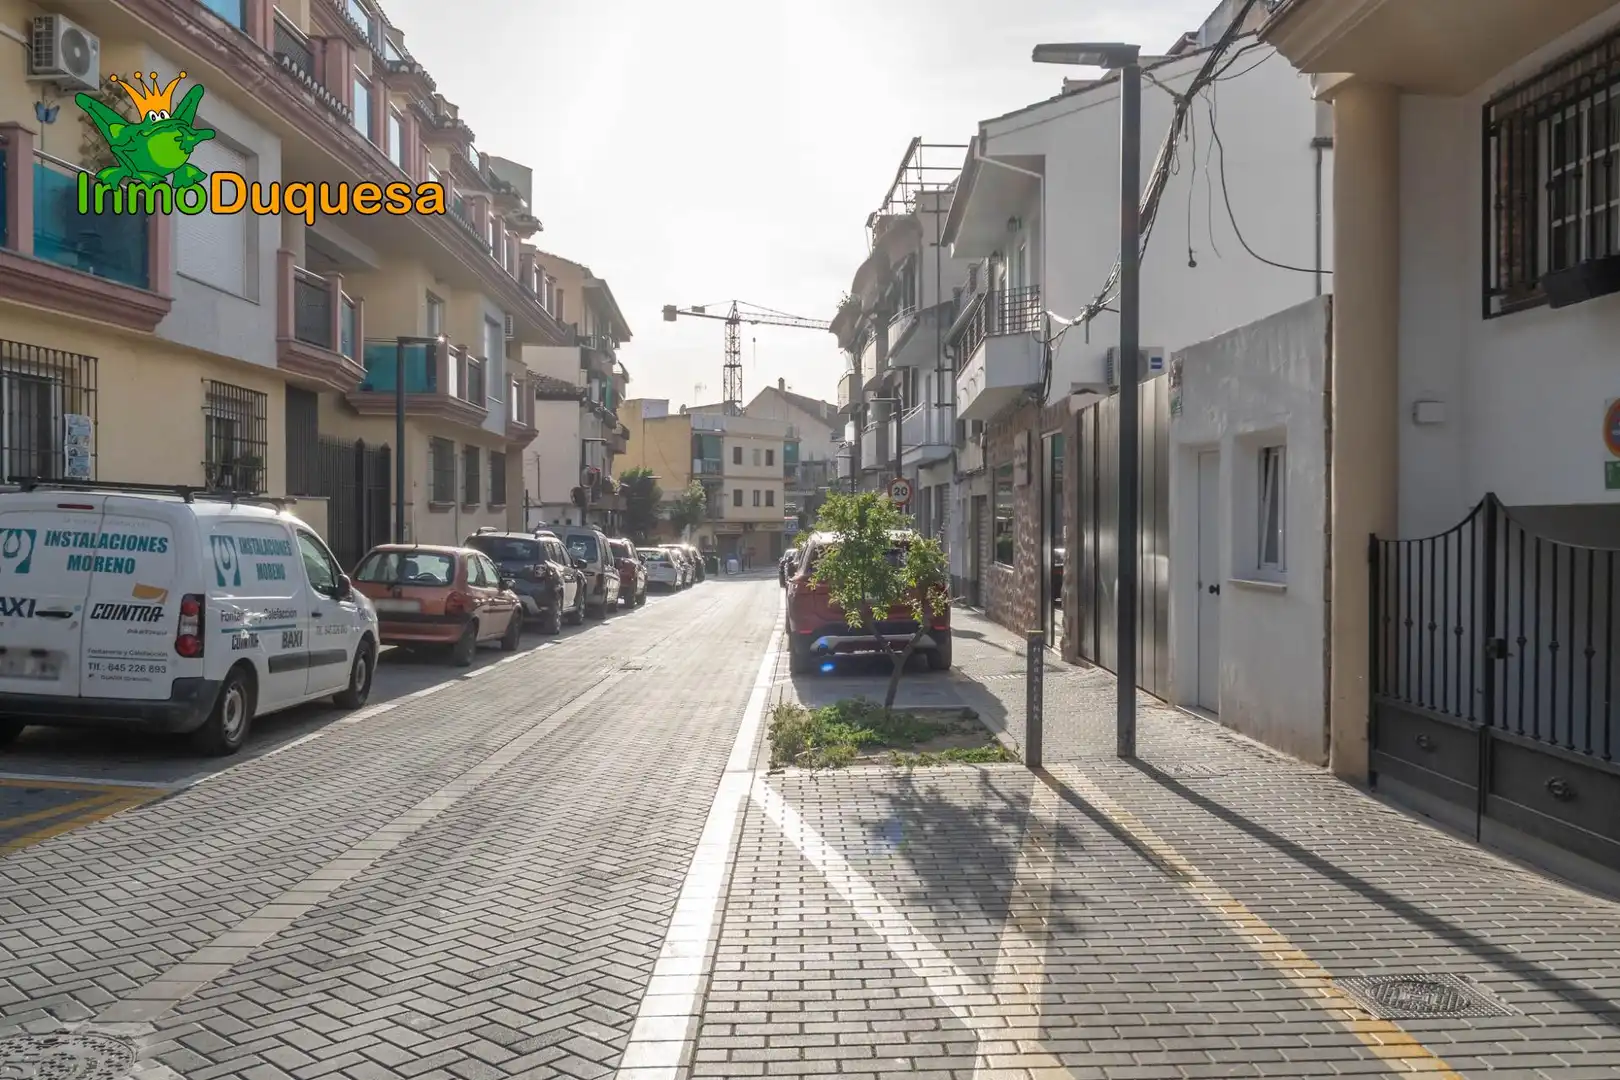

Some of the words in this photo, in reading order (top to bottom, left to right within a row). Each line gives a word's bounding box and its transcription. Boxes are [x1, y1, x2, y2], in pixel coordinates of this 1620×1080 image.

[894, 486, 908, 496] 20
[44, 530, 169, 553] INSTALACIONES
[239, 537, 292, 556] INSTALACIONES
[67, 554, 136, 574] MORENO
[256, 563, 286, 580] MORENO
[90, 603, 164, 622] COINTRA
[282, 630, 303, 649] BAXI
